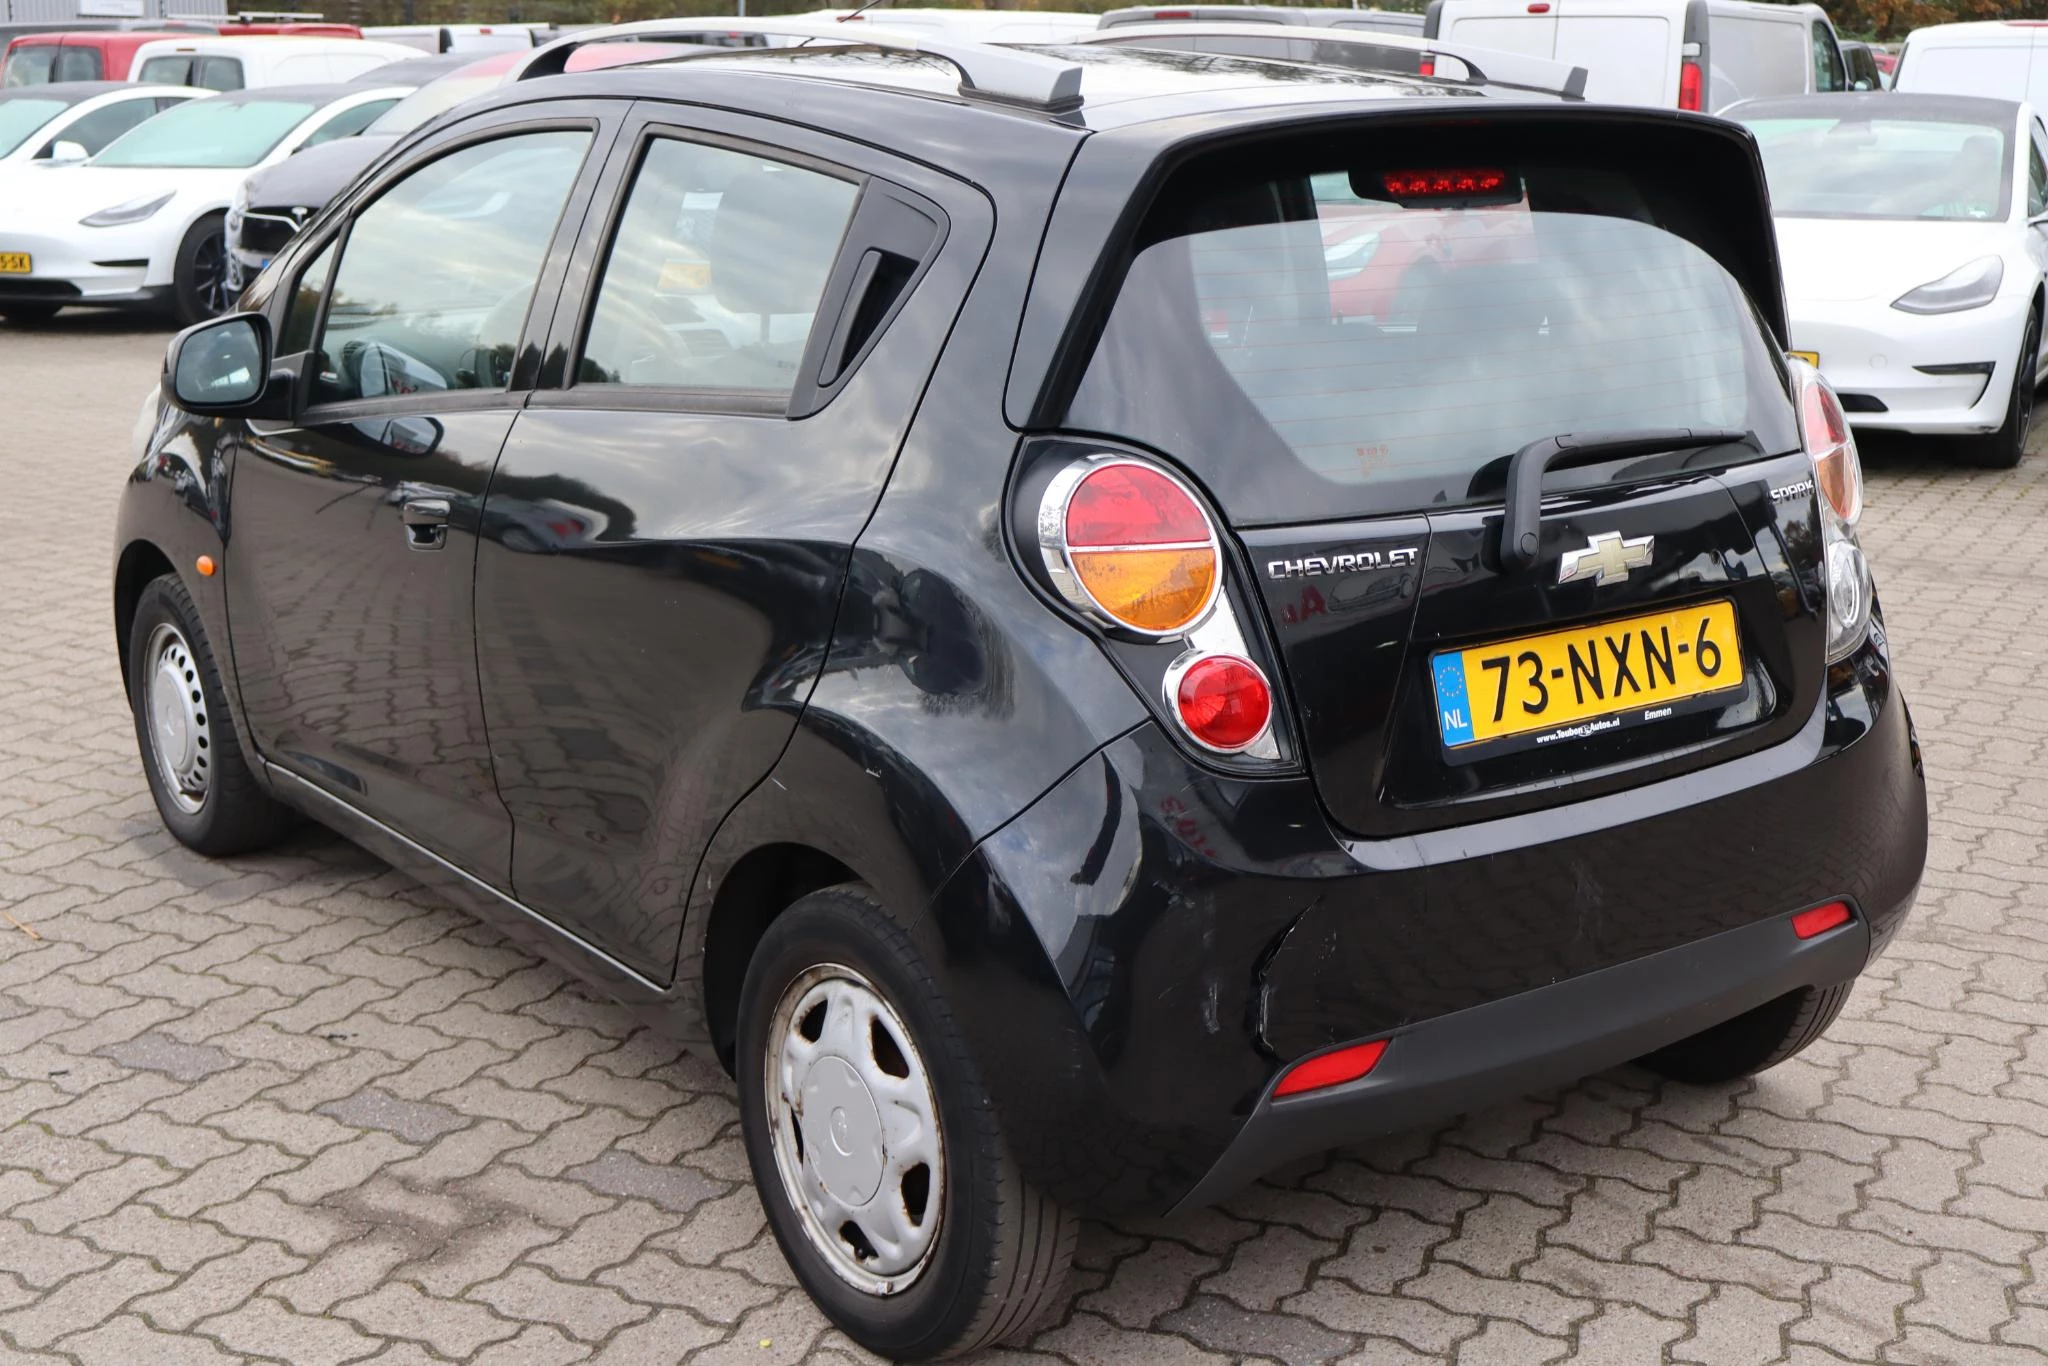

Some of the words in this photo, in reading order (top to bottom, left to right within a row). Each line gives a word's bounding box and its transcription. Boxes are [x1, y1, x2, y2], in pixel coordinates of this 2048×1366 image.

[1267, 548, 1418, 579] CHEVROLET
[1481, 617, 1722, 723] 73-NXN-6
[1444, 708, 1468, 730] NL
[1644, 707, 1672, 721] Emmen
